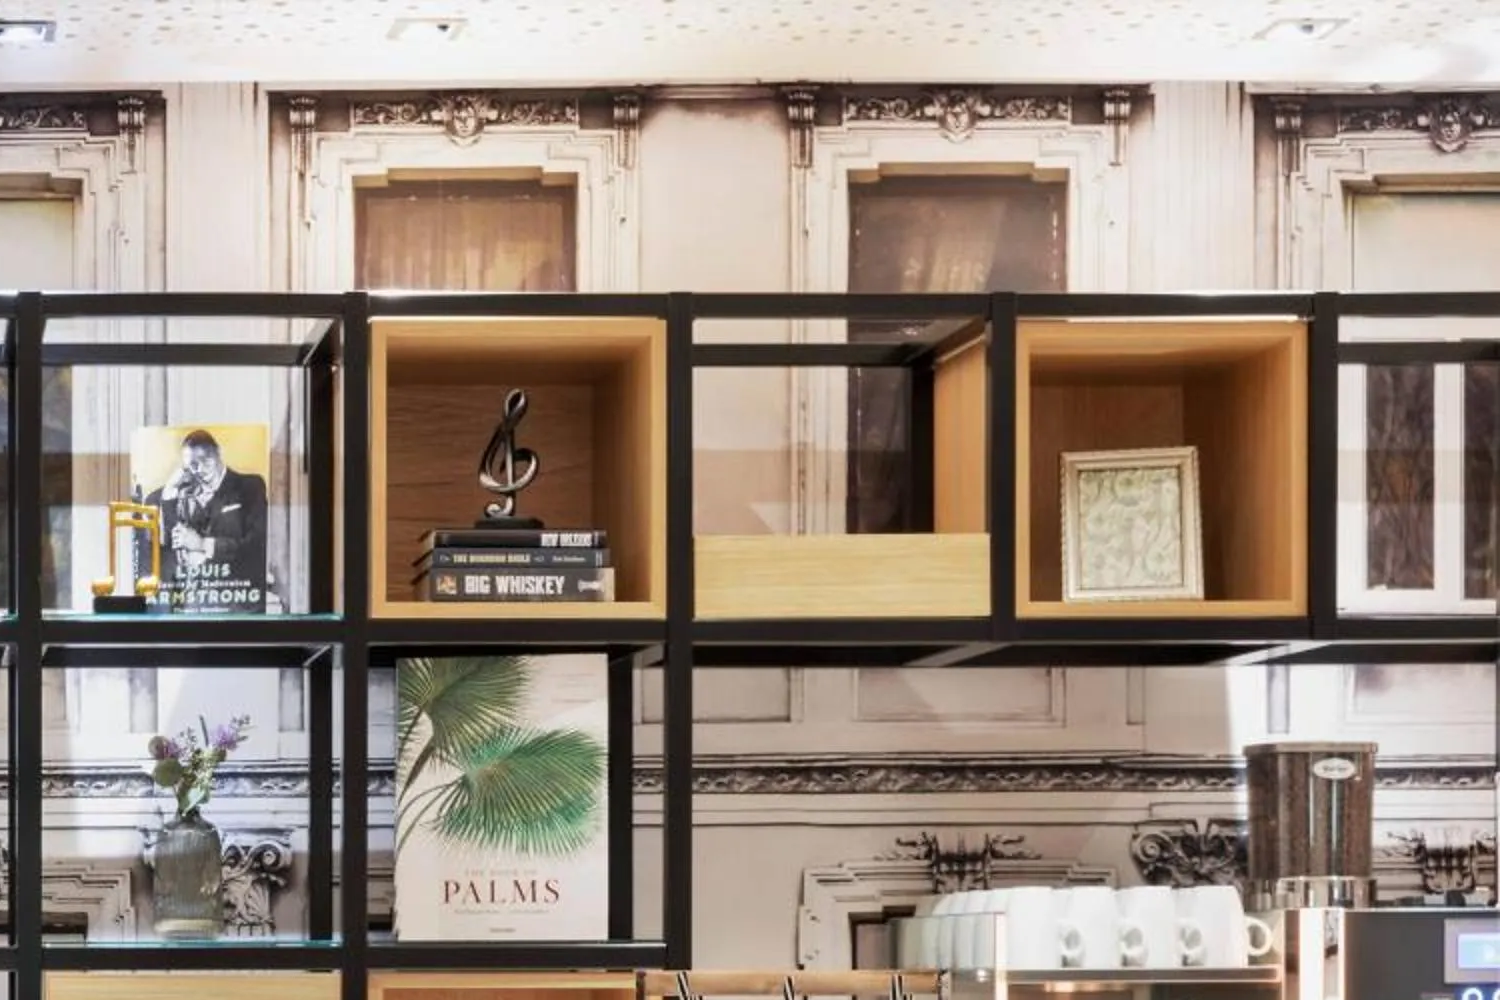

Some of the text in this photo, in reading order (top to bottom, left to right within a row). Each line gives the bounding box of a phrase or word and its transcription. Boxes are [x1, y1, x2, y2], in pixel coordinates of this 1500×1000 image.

[175, 563, 231, 579] LOUIS
[465, 575, 491, 595] BIG
[495, 575, 565, 595] WHISKEY
[146, 589, 260, 604] ARMSTRONG
[444, 880, 560, 904] PALMS
